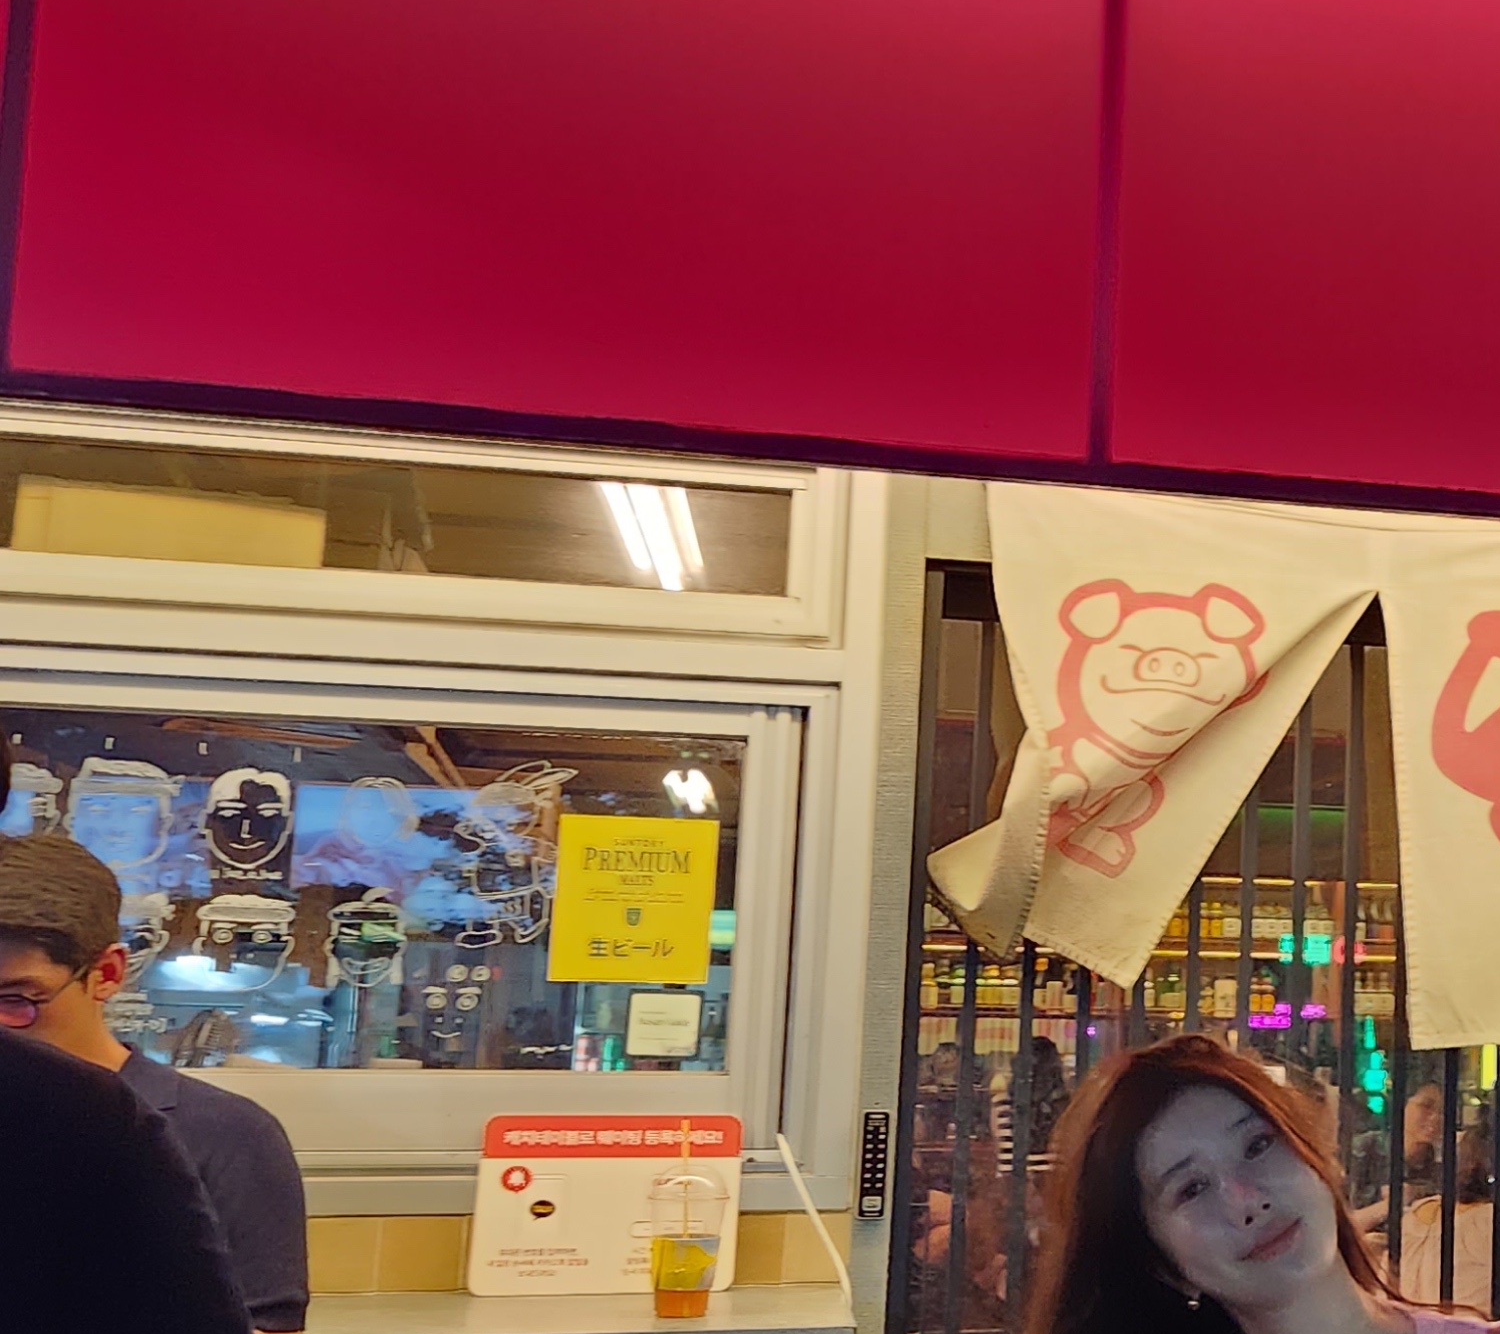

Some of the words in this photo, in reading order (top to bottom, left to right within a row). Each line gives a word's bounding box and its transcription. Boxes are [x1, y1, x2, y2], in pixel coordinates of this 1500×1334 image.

[583, 847, 692, 874] PREMIUM
[588, 937, 675, 958] 生ビール
